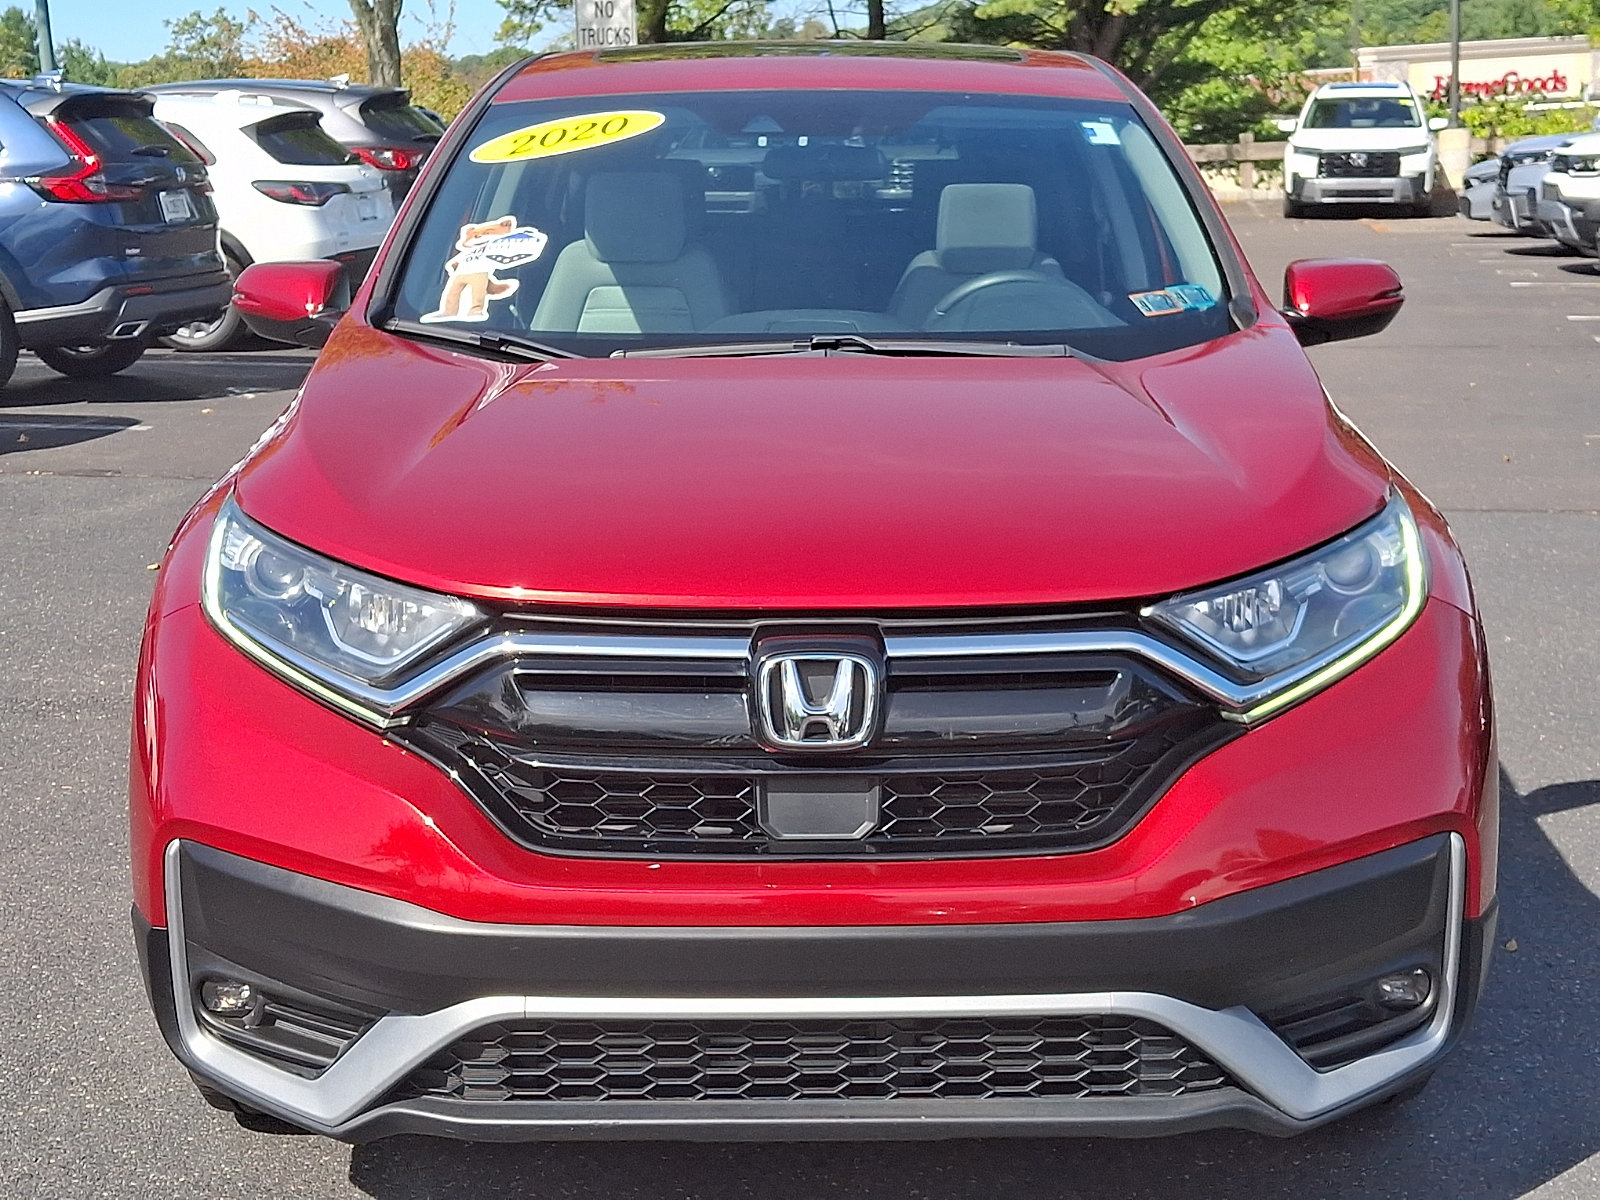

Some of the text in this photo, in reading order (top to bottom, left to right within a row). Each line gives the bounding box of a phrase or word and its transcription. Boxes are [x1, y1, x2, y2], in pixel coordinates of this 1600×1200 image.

[594, 1, 614, 18] NO
[581, 27, 631, 45] TRUCKS
[507, 116, 629, 157] 2020
